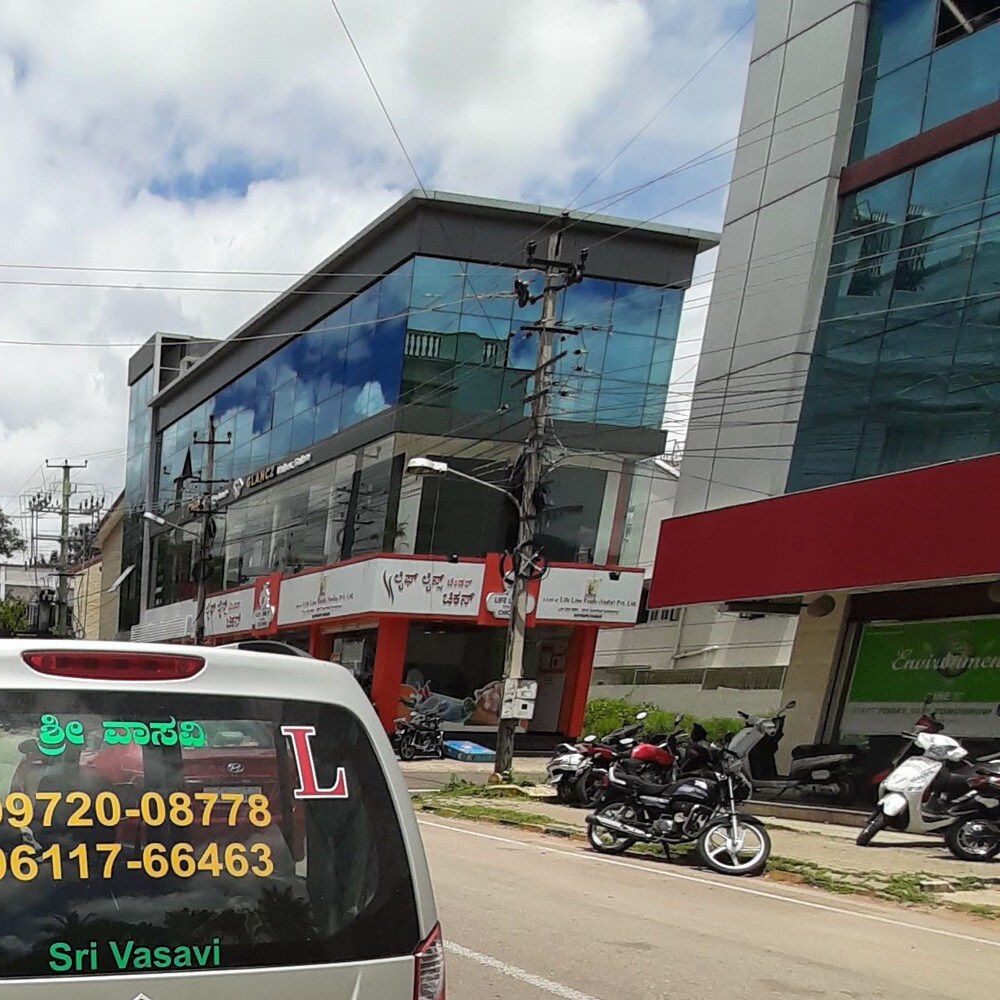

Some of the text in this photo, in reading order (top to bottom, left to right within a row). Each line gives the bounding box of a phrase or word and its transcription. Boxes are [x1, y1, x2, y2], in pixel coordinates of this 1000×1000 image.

[37, 713, 208, 757] ಶ್ರೀ ವಾಸವಿ
[280, 725, 349, 800] L
[48, 937, 223, 973] Sri Vasavi
